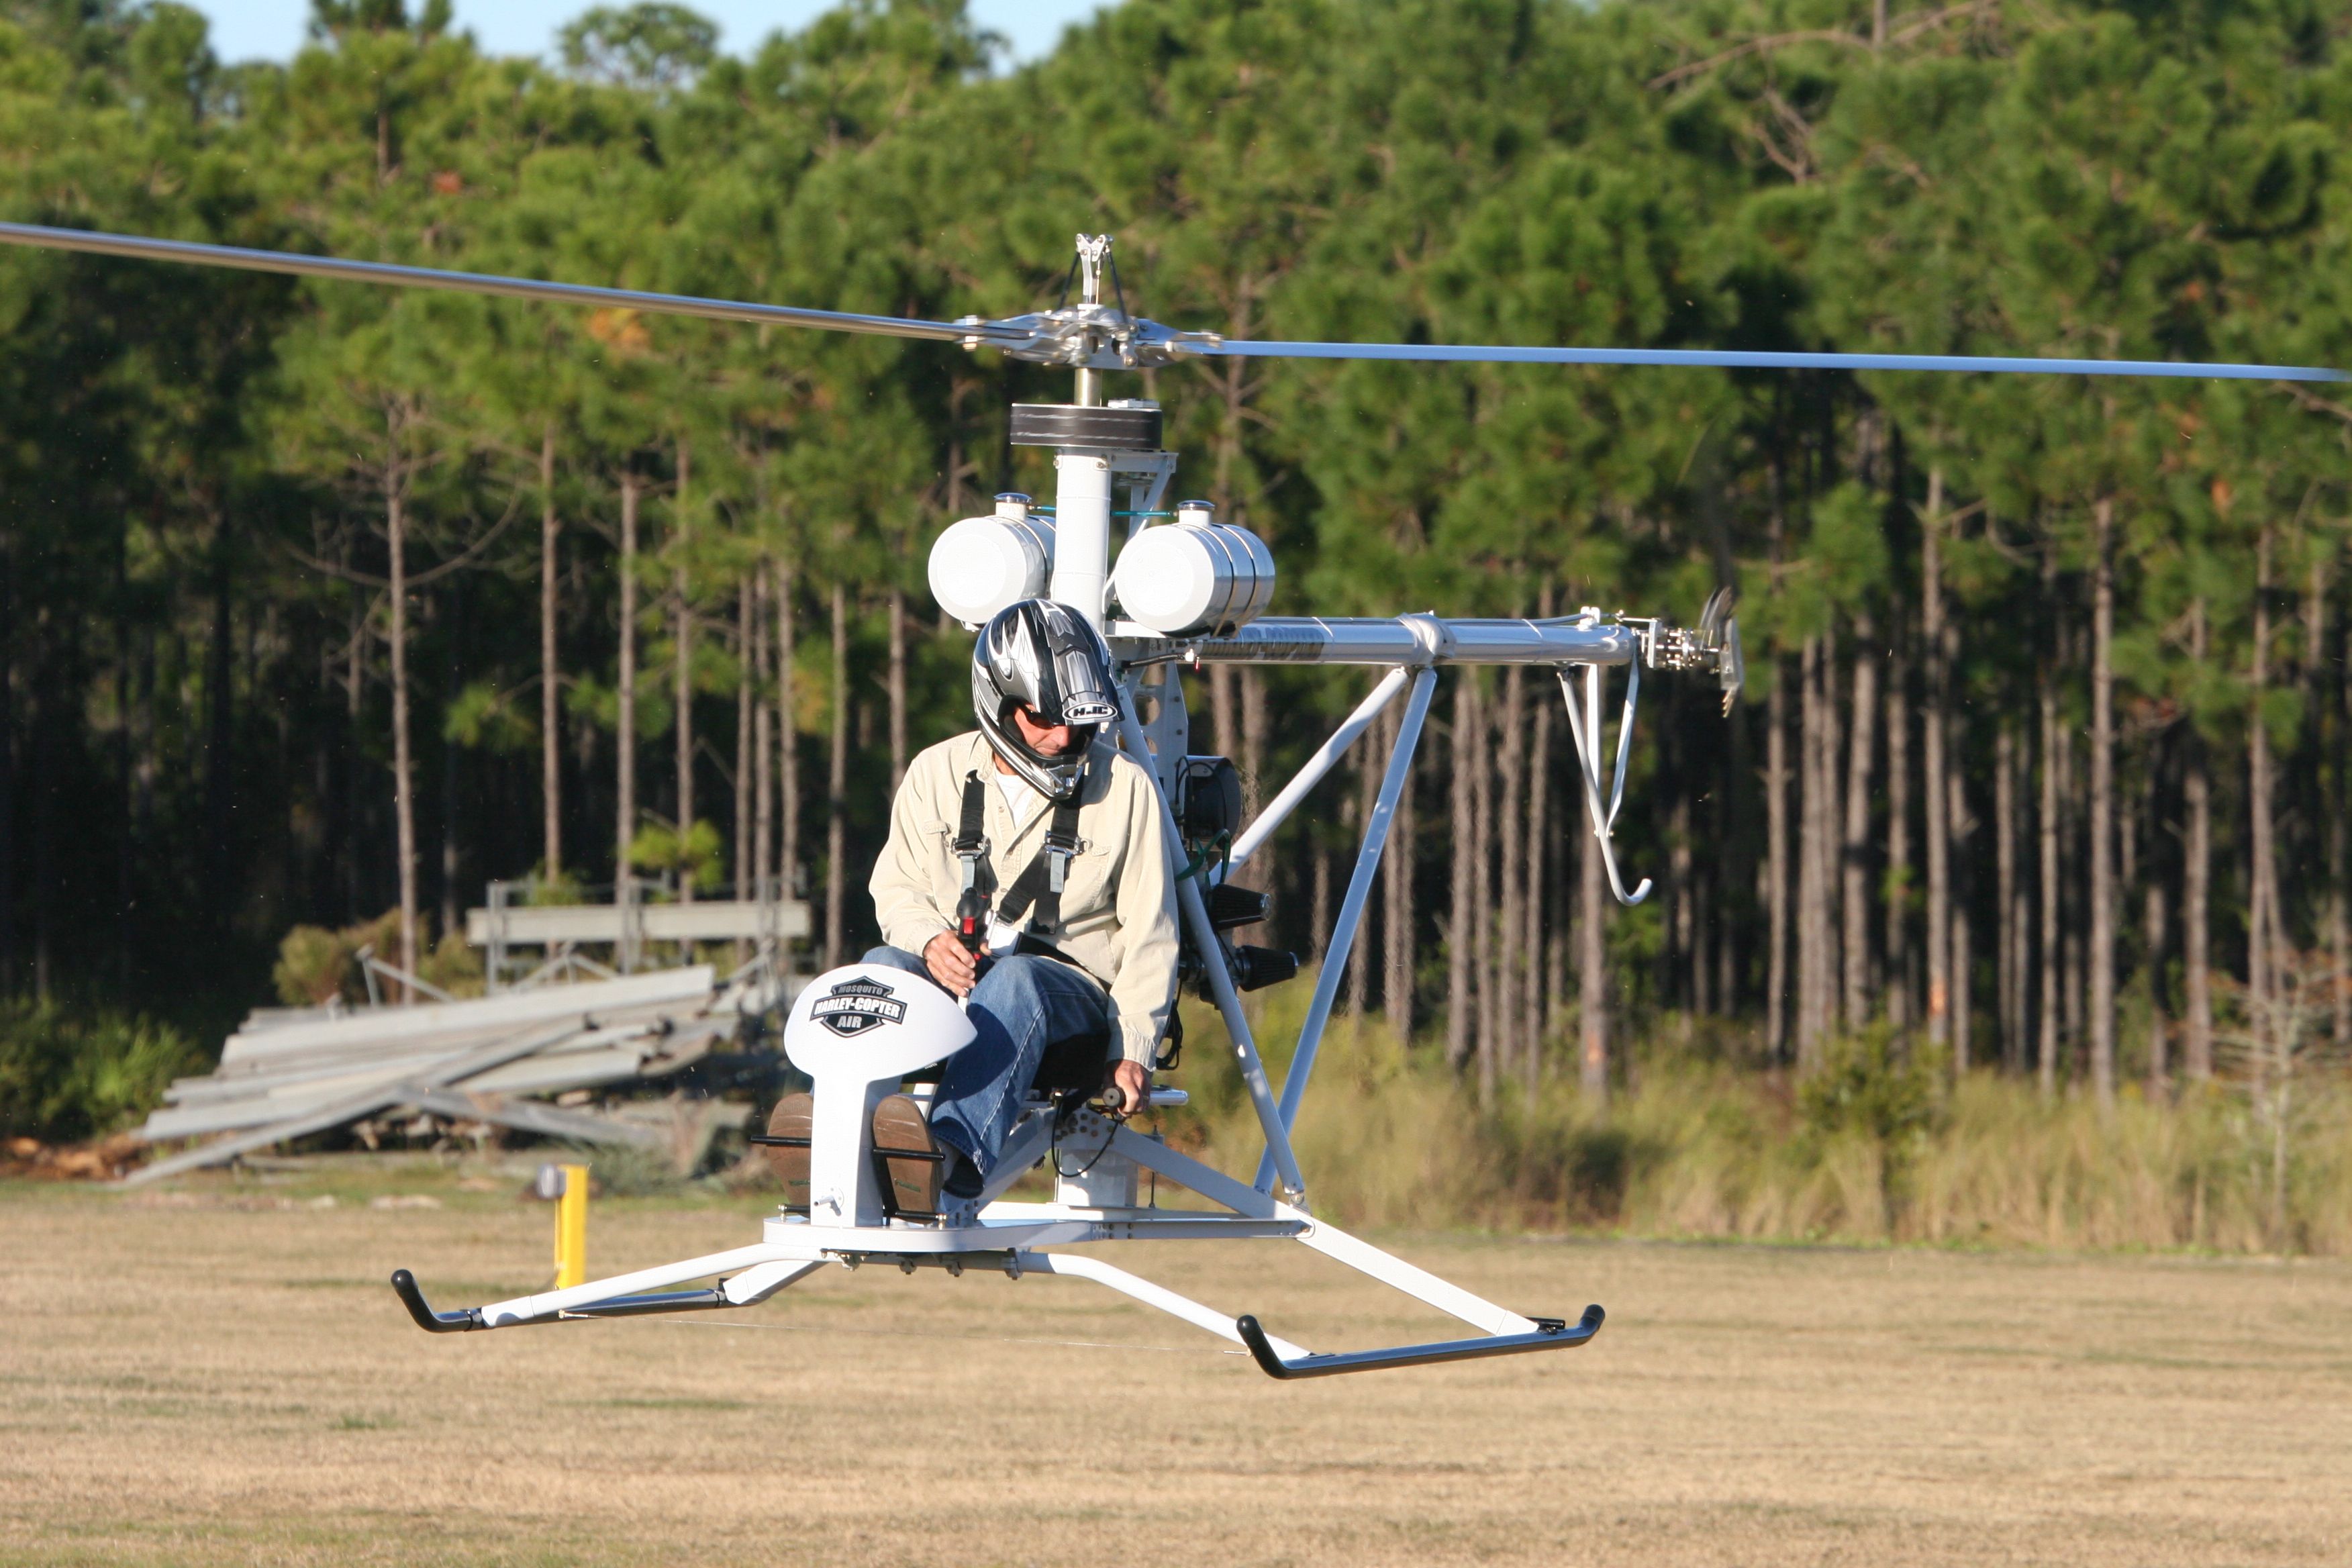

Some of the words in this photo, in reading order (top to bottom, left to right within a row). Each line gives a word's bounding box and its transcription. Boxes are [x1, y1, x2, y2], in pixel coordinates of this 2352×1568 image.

[1073, 706, 1108, 716] HJC
[838, 985, 883, 995] MOSQUITO
[814, 997, 901, 1018] HARLEY-COPTER
[837, 1016, 862, 1028] AIR
